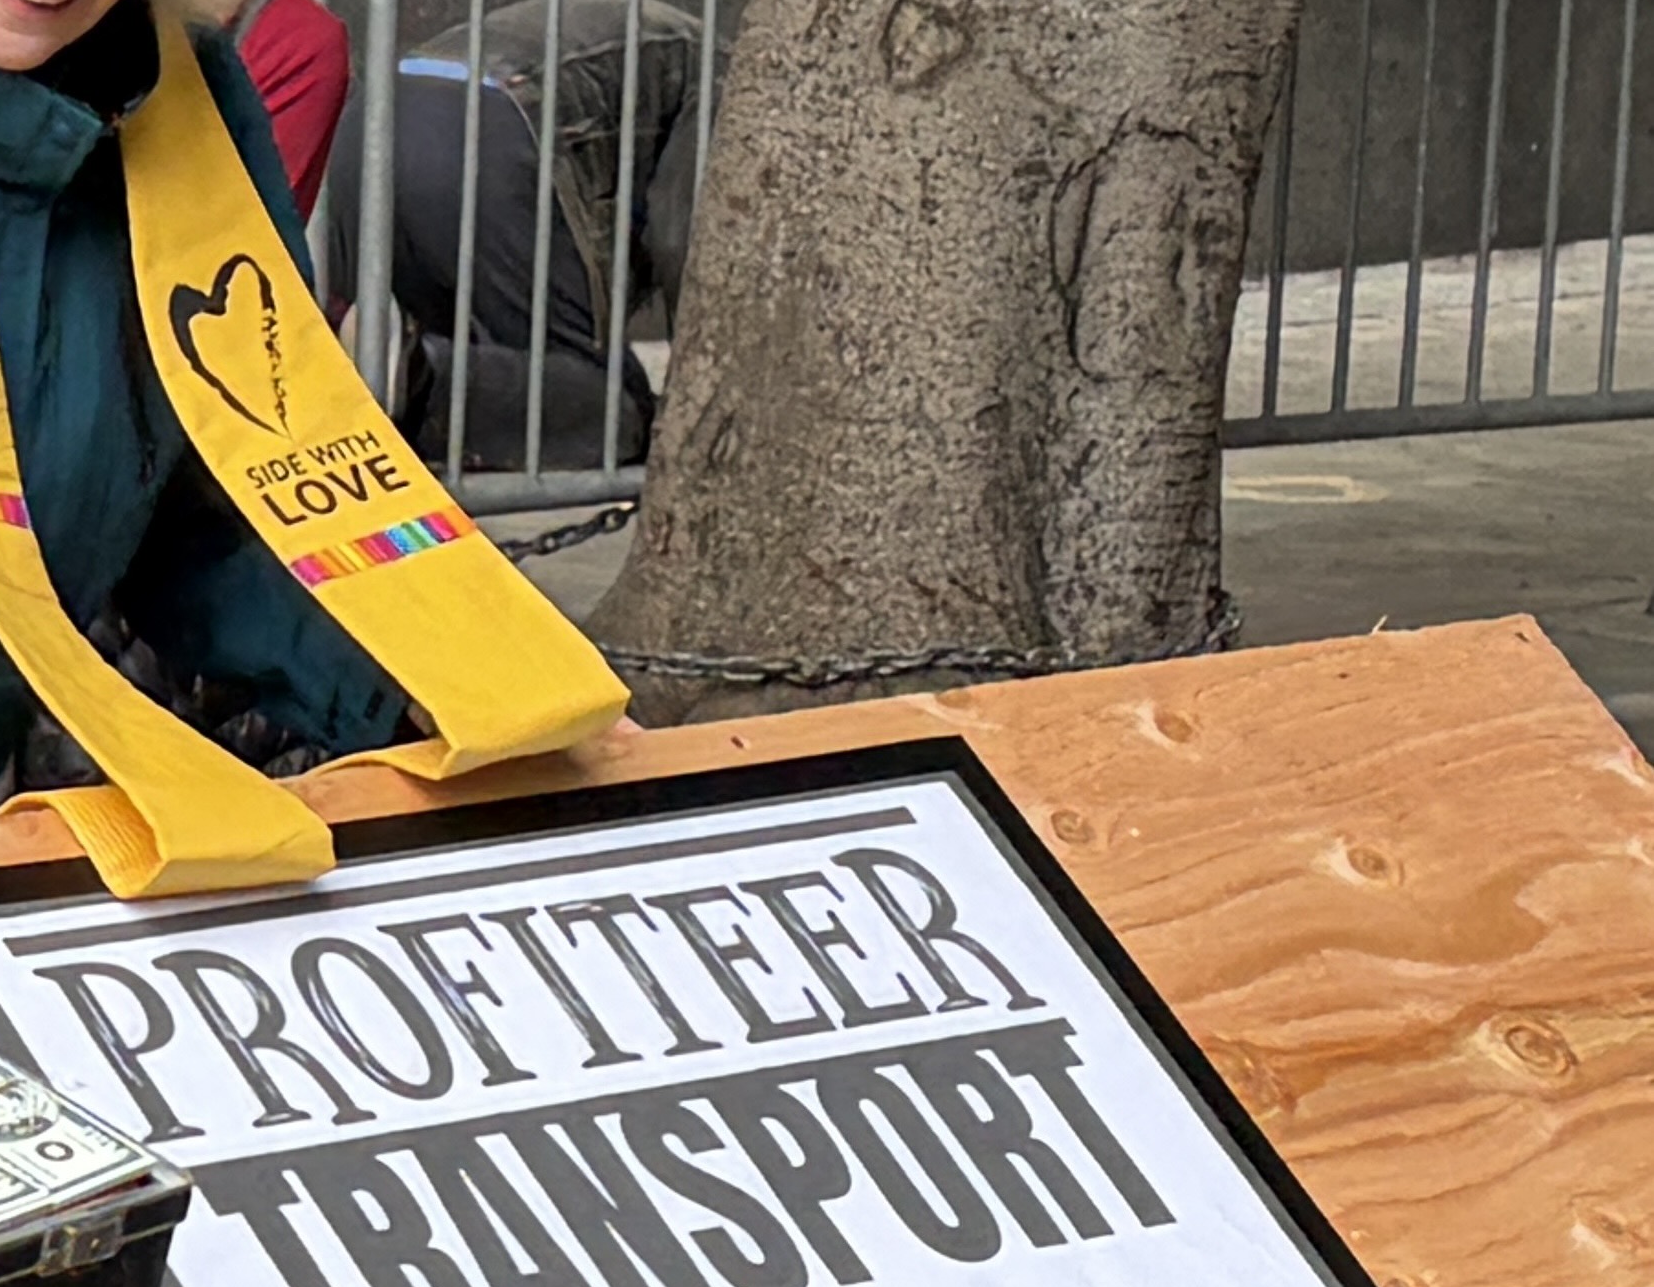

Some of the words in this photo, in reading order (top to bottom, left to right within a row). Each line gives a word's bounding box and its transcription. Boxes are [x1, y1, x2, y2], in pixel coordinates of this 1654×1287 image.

[246, 452, 308, 489] SIDE
[305, 429, 381, 467] WITH
[261, 453, 411, 526] LOVE
[33, 844, 1047, 1142] PROFITEER
